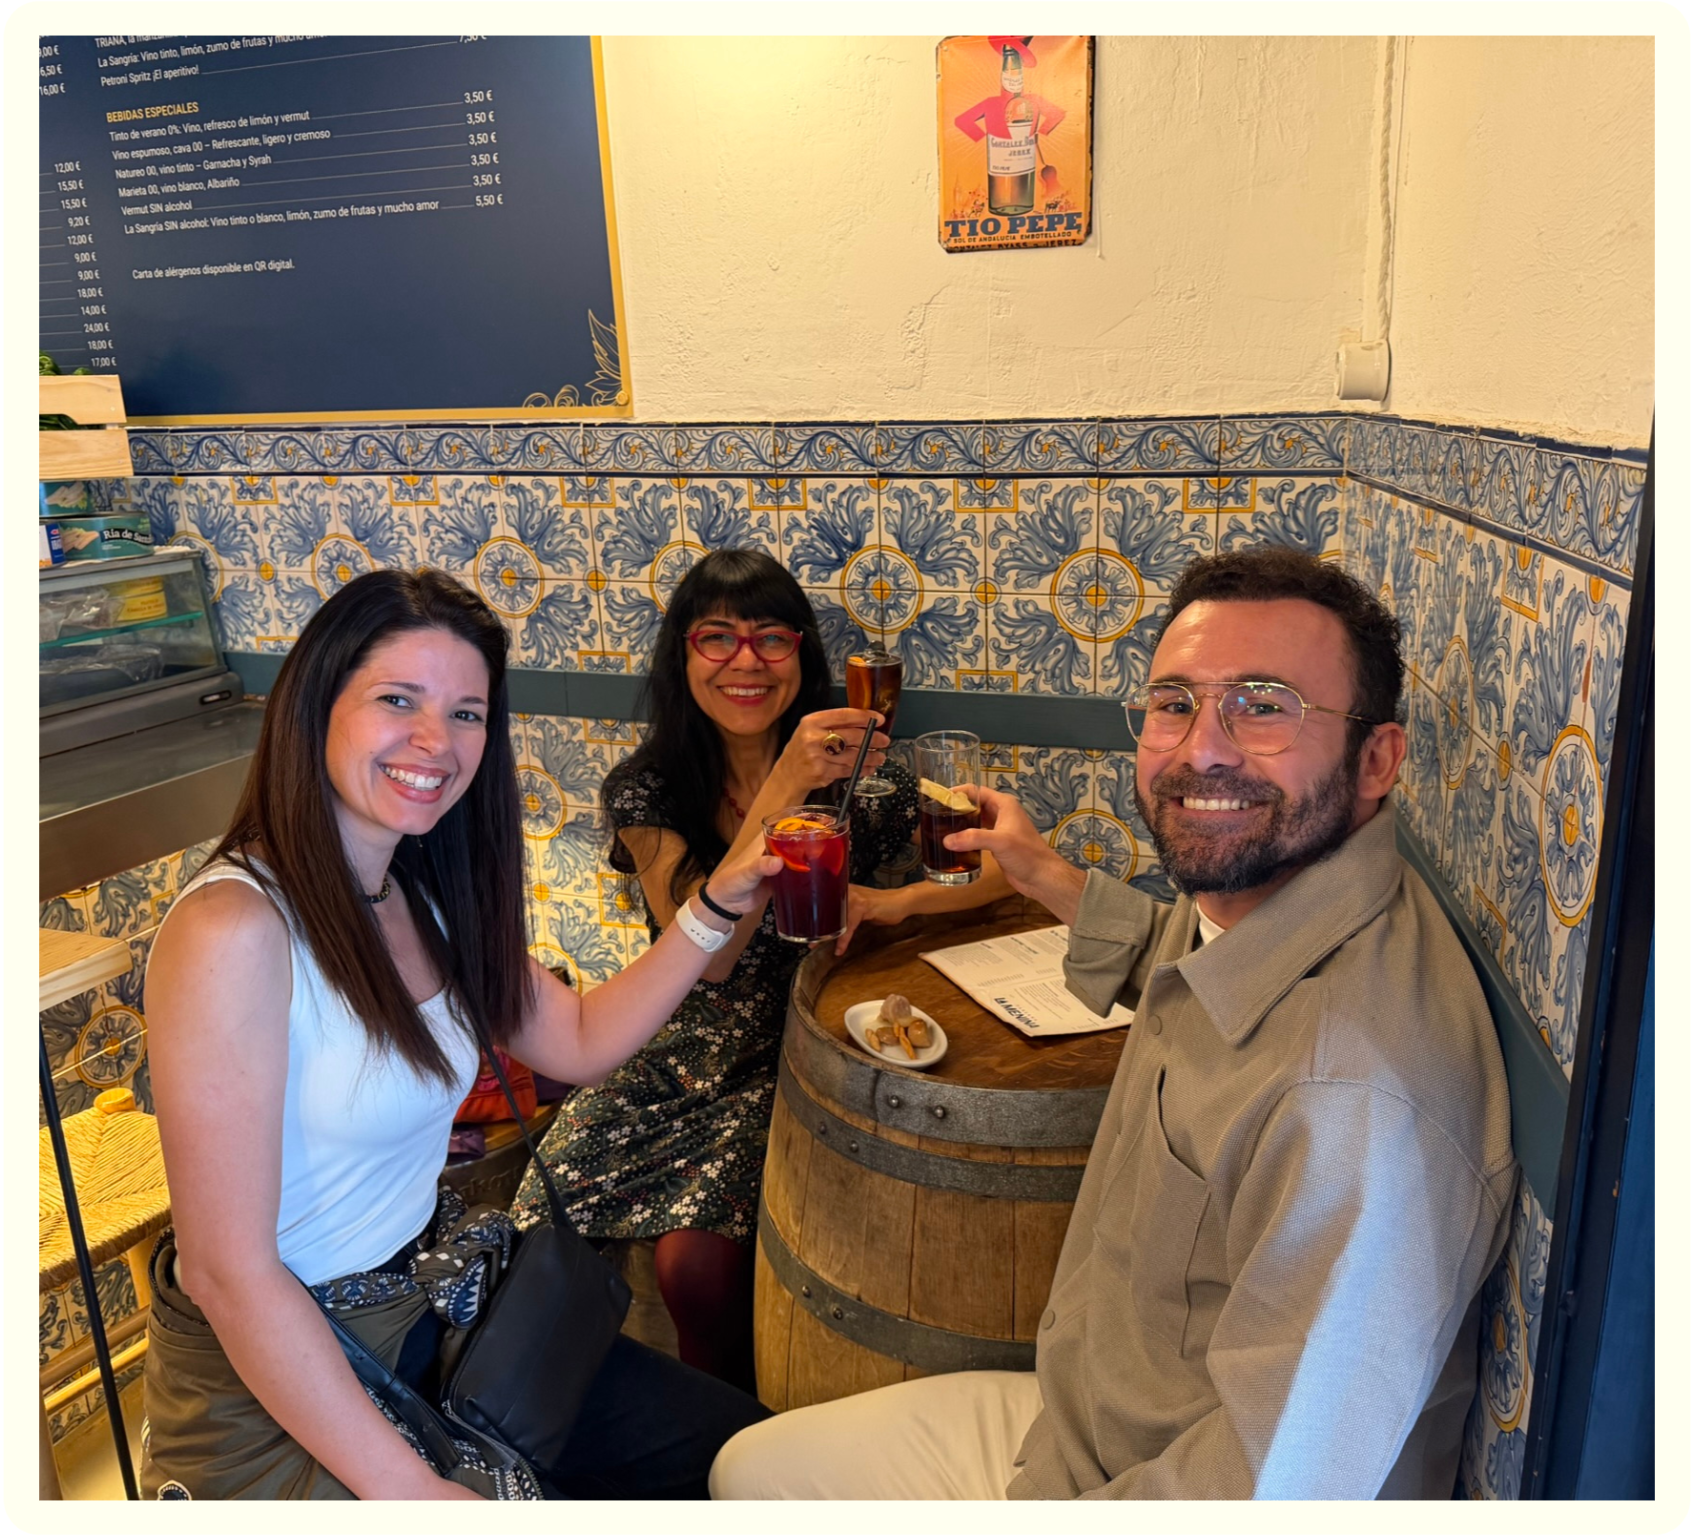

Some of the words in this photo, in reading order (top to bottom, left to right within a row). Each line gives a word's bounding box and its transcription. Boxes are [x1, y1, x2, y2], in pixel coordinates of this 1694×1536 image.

[54, 44, 60, 56] €
[98, 57, 108, 68] La
[140, 51, 160, 62] Vino
[160, 48, 180, 60] tinto,
[180, 44, 206, 56] limón,
[206, 43, 228, 53] zumo
[230, 38, 241, 50] de
[242, 36, 267, 48] frutas
[56, 64, 63, 75] €
[128, 71, 152, 85] Spritz
[163, 64, 200, 80] aperitivo!
[60, 82, 66, 94] €
[106, 108, 144, 123] BEBIDAS
[144, 102, 200, 118] ESPECIALES
[108, 131, 129, 142] Tinto
[130, 128, 140, 140] de
[140, 127, 167, 138] verano
[182, 122, 204, 134] Vino,
[204, 119, 237, 132] refresco
[238, 116, 248, 128] de
[249, 114, 273, 126] limón
[274, 114, 280, 126] y
[280, 110, 310, 122] vermut
[464, 90, 484, 104] 3,50
[486, 90, 493, 101] €
[112, 150, 130, 160] Vino
[130, 146, 173, 160] espumoso,
[173, 144, 192, 154] cava
[192, 140, 204, 152] 00
[212, 136, 262, 150] Refrescante,
[262, 134, 286, 147] ligero
[286, 134, 293, 145] y
[294, 130, 331, 142] cremoso
[466, 112, 487, 126] 3,50
[488, 110, 495, 122] €
[114, 167, 145, 180] Natureo
[158, 164, 176, 175] vino
[176, 162, 195, 173] tinto
[202, 157, 241, 170] Garnacha
[242, 158, 248, 169] y
[248, 154, 272, 168] Syrah
[468, 132, 489, 146] 3,50
[490, 132, 498, 143] €
[54, 161, 74, 174] 12,00
[75, 160, 82, 171] €
[118, 186, 148, 198] Marieta
[160, 183, 178, 194] vino
[178, 180, 206, 192] blanco,
[207, 176, 240, 190] Albariño
[470, 153, 491, 167] 3,50
[492, 152, 500, 164] €
[57, 180, 78, 192] 15,50
[78, 179, 84, 190] €
[121, 205, 149, 216] Vermut
[149, 202, 164, 214] SIN
[164, 200, 192, 212] alcohol
[472, 174, 494, 188] 3,50
[494, 172, 502, 185] €
[61, 198, 81, 210] 15,50
[82, 197, 88, 208] €
[124, 224, 134, 235] La
[164, 220, 178, 232] SIN
[210, 216, 228, 228] Vino
[229, 215, 248, 226] tinto
[248, 216, 256, 224] o
[256, 212, 286, 224] blanco,
[286, 209, 312, 221] limón,
[313, 208, 336, 219] zumo
[338, 206, 350, 218] de
[350, 204, 376, 216] frutas
[377, 205, 383, 216] y
[384, 201, 414, 214] mucho
[416, 200, 440, 211] amor
[476, 194, 496, 208] 5,50
[497, 194, 504, 206] €
[68, 216, 84, 228] 9,20
[84, 215, 91, 226] €
[944, 218, 1001, 238] TIO
[1007, 212, 1082, 234] PEPE
[67, 234, 88, 246] 12,00
[88, 233, 94, 244] €
[979, 234, 1016, 242] ANDALUCIA
[1020, 230, 1072, 240] EMBOTELLADO
[74, 252, 90, 264] 9,00
[91, 251, 98, 262] €
[78, 270, 94, 282] 9,00
[94, 269, 100, 280] €
[132, 268, 153, 280] Carta
[154, 268, 164, 278] de
[164, 266, 202, 279] alérgenos
[202, 262, 242, 276] disponible
[242, 262, 254, 272] en
[254, 260, 267, 272] QR
[268, 258, 296, 272] digital.
[77, 287, 97, 299] 18,00
[98, 286, 104, 298] €
[80, 304, 100, 316] 14,00
[101, 304, 108, 315] €
[84, 322, 104, 334] 24,00
[104, 322, 110, 332] €
[87, 340, 107, 351] 18,00
[108, 339, 114, 350] €
[91, 356, 110, 368] 17,00
[111, 356, 118, 367] €
[121, 528, 134, 540] de
